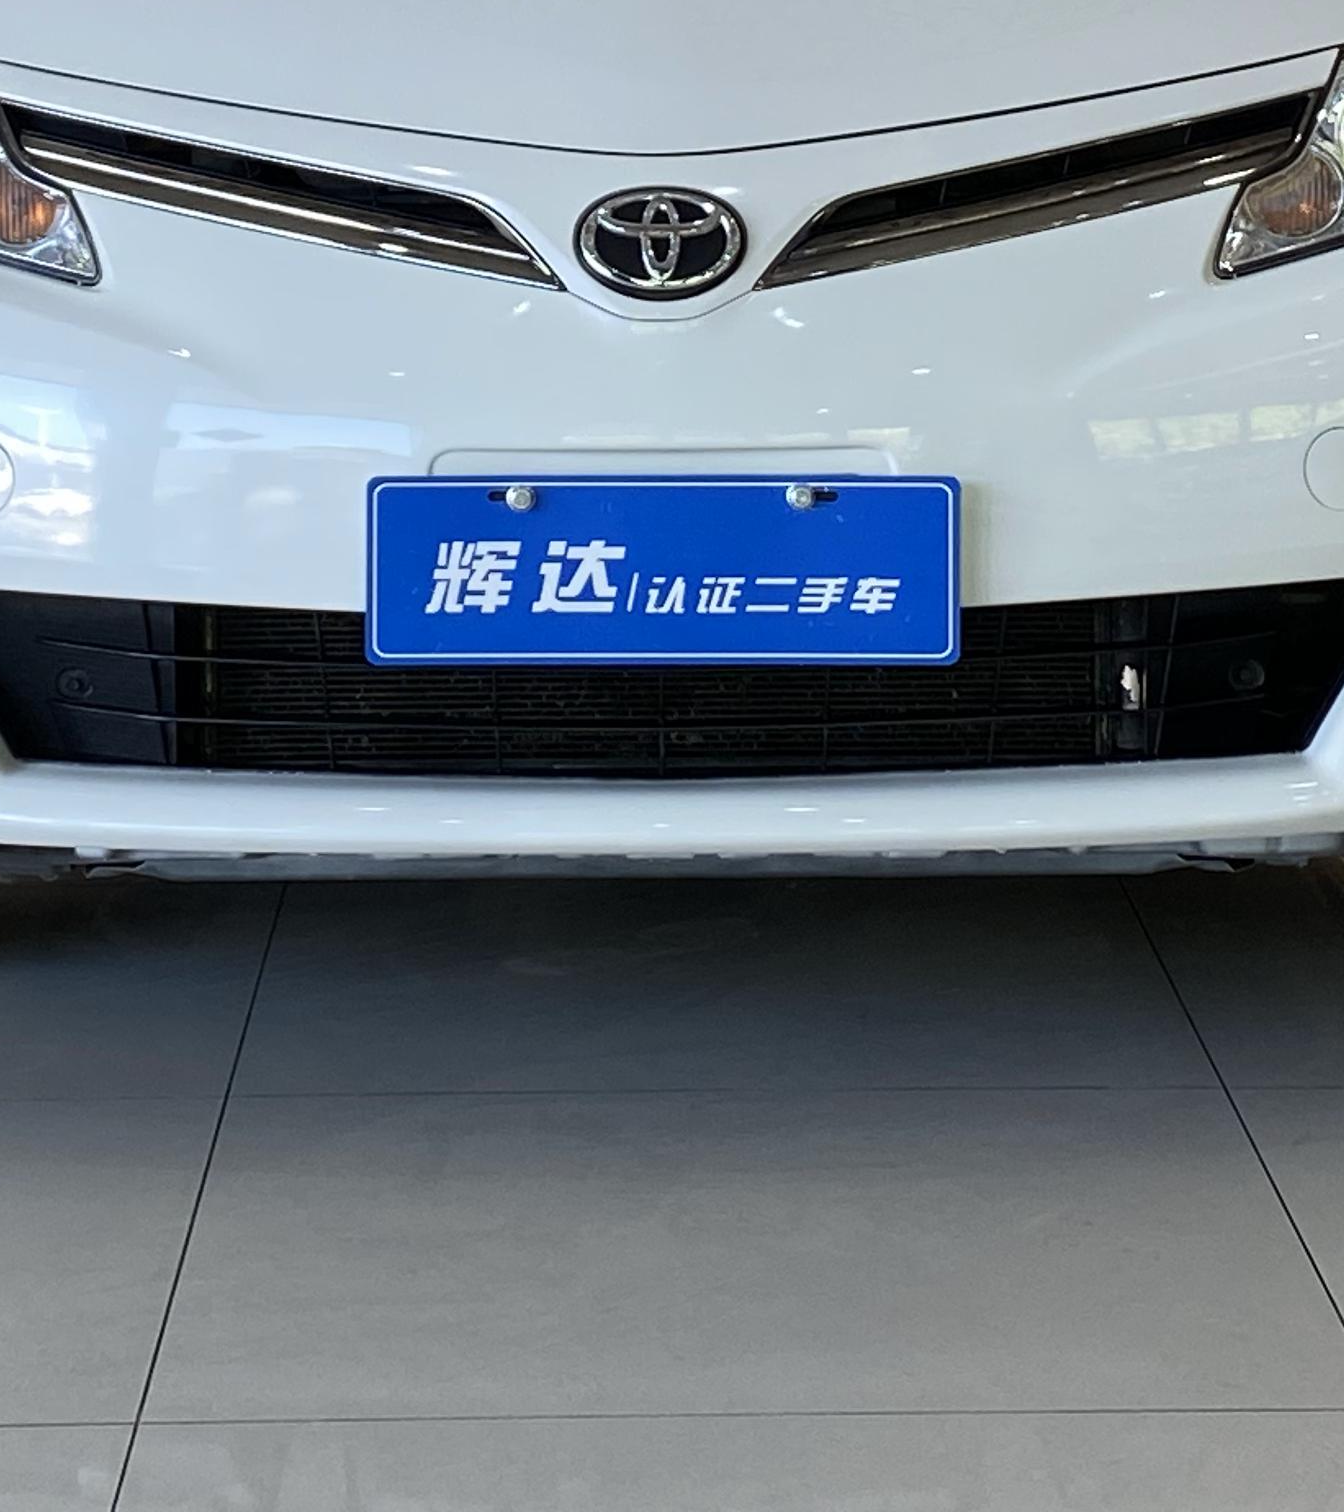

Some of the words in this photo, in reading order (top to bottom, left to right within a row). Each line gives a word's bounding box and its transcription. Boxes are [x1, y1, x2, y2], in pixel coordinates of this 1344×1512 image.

[424, 539, 626, 615] 辉达
[644, 576, 901, 615] 认证二手车
